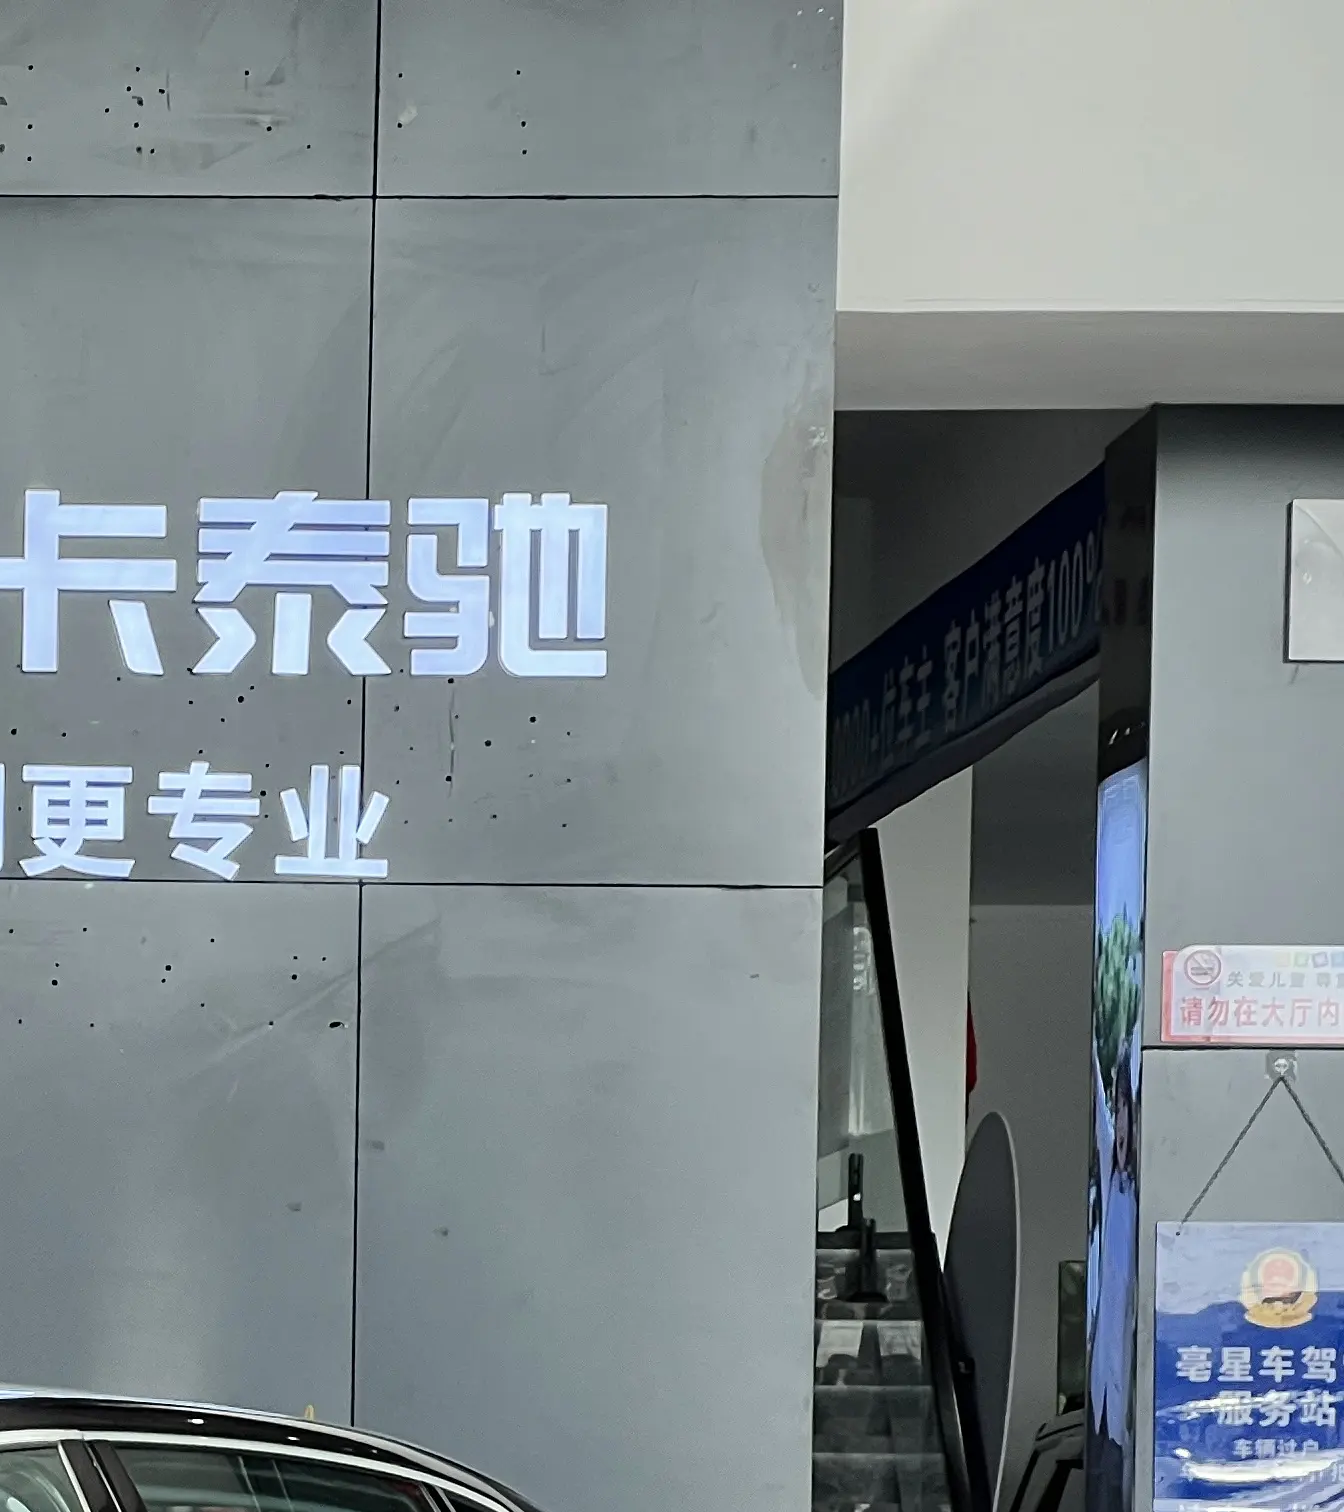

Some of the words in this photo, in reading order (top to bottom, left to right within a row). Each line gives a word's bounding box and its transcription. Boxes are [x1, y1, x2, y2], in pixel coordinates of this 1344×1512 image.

[1180, 996, 1340, 1028] 请勿在大厅内
[1175, 1345, 1344, 1383] 亳星车驾
[1218, 1389, 1337, 1427] 服务站
